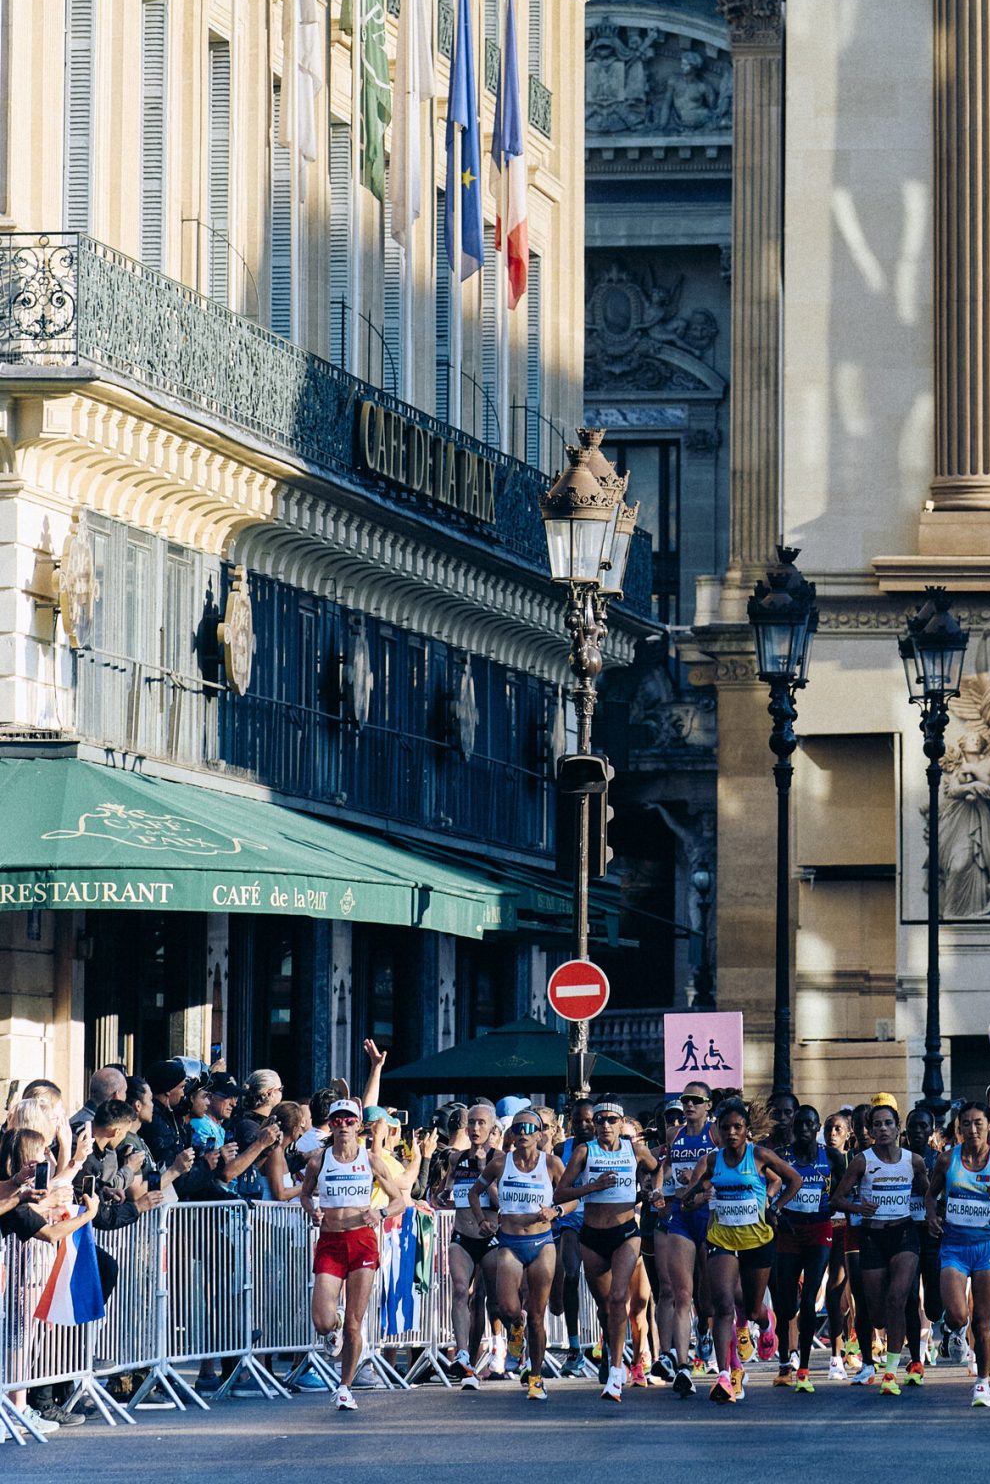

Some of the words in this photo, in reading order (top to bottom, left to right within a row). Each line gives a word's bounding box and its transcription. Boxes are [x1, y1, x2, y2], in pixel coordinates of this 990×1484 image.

[458, 448, 496, 525] PAIX
[0, 882, 173, 904] RESTAURANT
[212, 880, 261, 906] CAFÉ
[270, 886, 288, 907] de
[294, 887, 305, 908] la
[326, 1185, 370, 1197] ELMORE
[502, 1191, 544, 1204] LINDWURM
